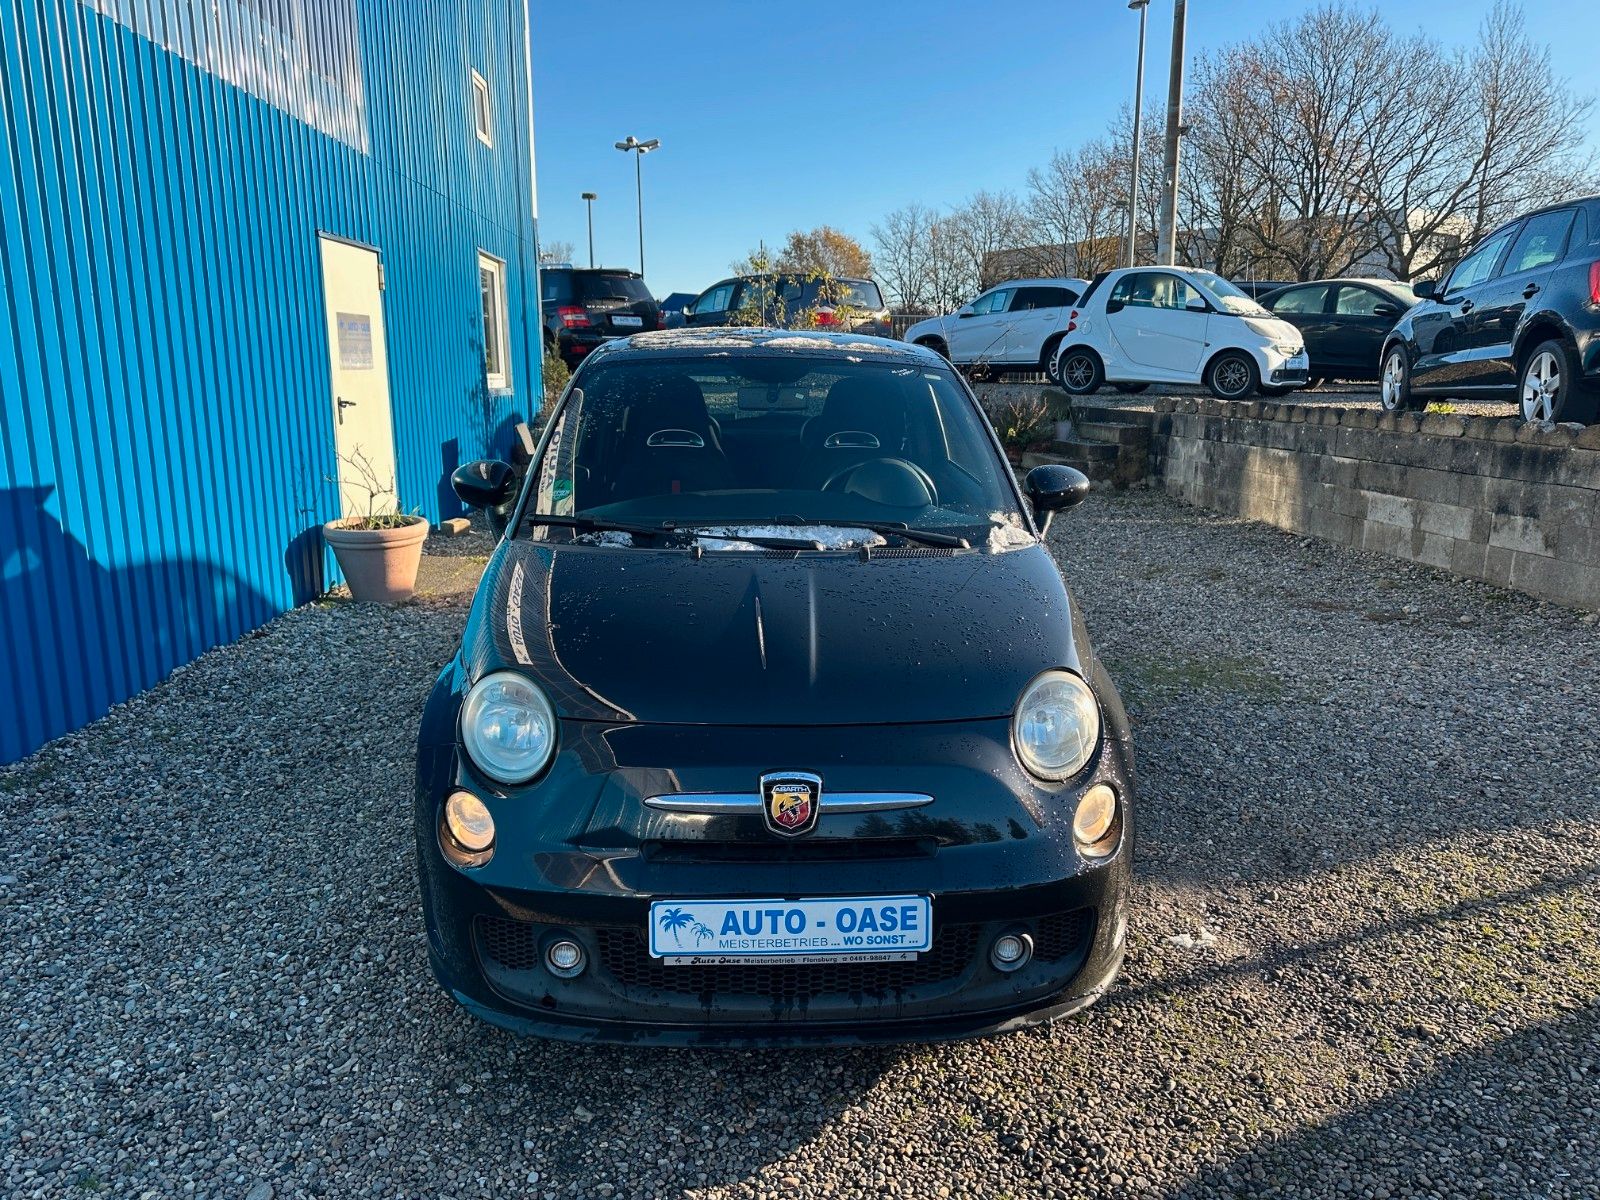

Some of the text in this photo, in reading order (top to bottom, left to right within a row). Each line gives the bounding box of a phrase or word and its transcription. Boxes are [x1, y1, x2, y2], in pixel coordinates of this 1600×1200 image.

[719, 909, 807, 936] AUTO
[835, 905, 918, 934] OASE
[718, 938, 829, 949] MEISTERBETRIEB
[843, 936, 864, 946] WO
[866, 934, 906, 946] SONST
[690, 956, 716, 965] Auto
[743, 956, 796, 964] Meisterbetrieb
[802, 956, 838, 964] Flensburg
